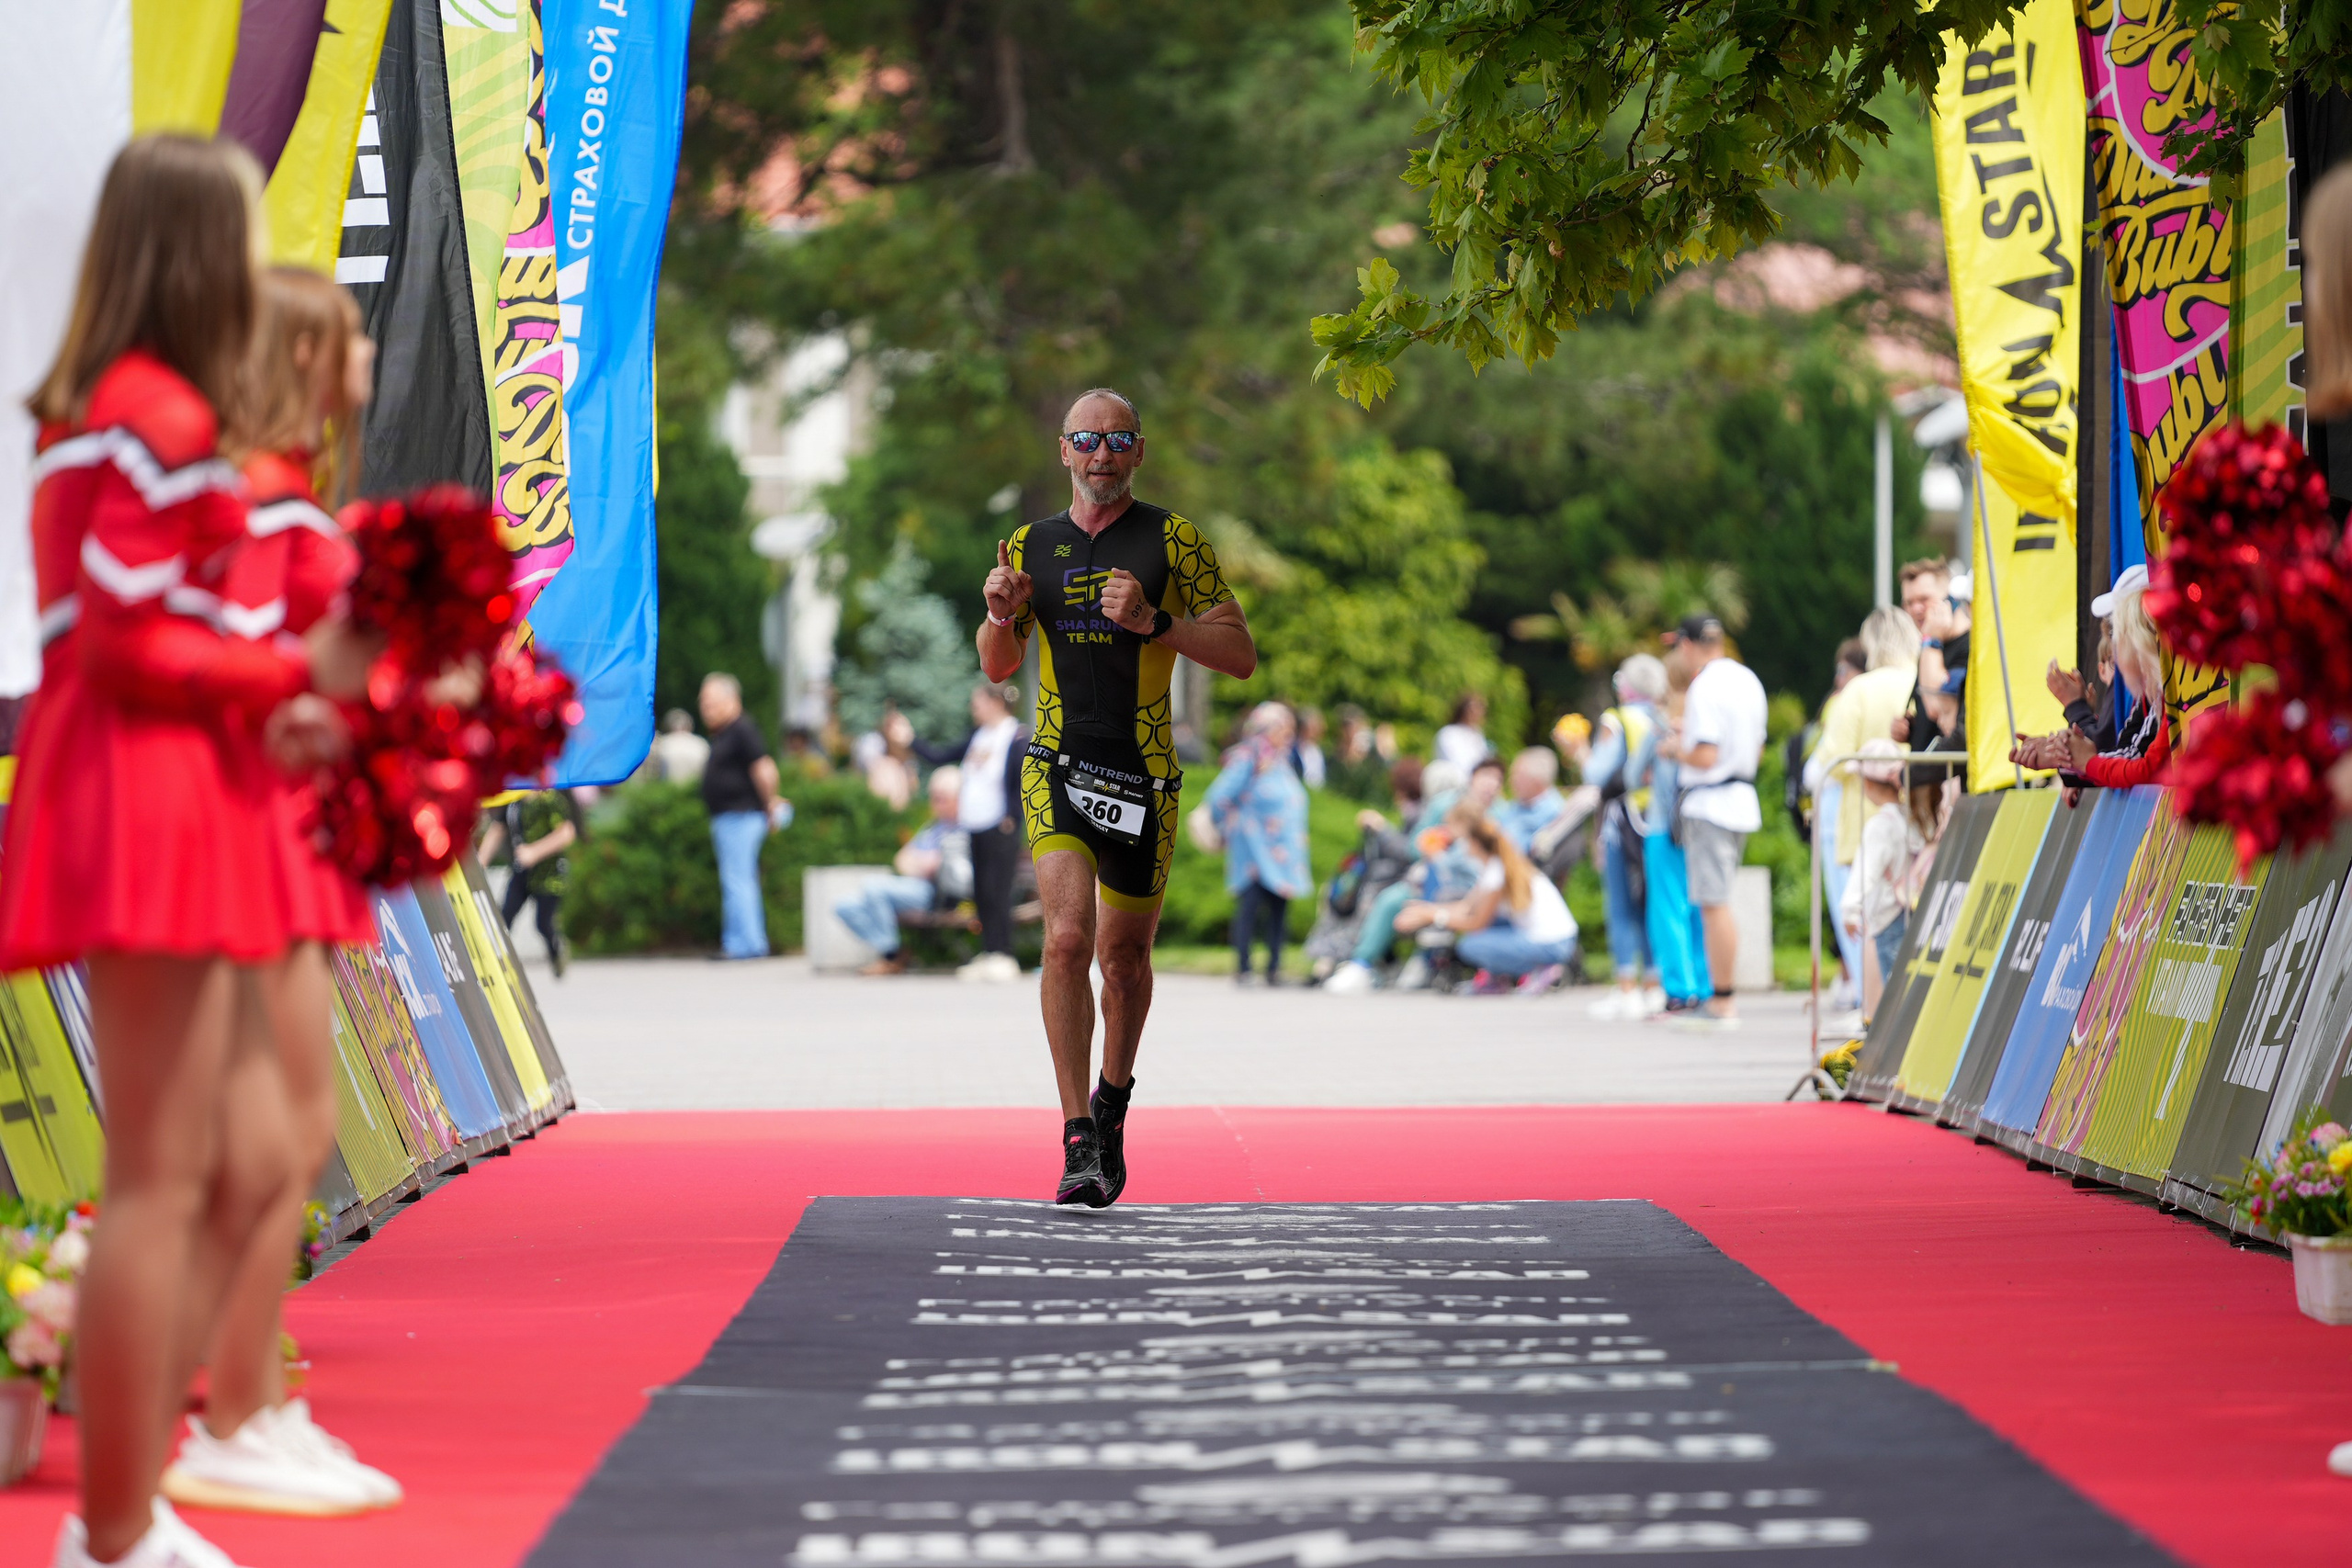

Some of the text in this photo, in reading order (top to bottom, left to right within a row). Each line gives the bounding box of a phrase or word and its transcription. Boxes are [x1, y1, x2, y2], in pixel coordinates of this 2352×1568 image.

[567, 26, 619, 250] СТРАХОВОЙ
[1962, 42, 2042, 239] STAR
[1067, 632, 1113, 645] TEAM
[1081, 795, 1123, 825] 260
